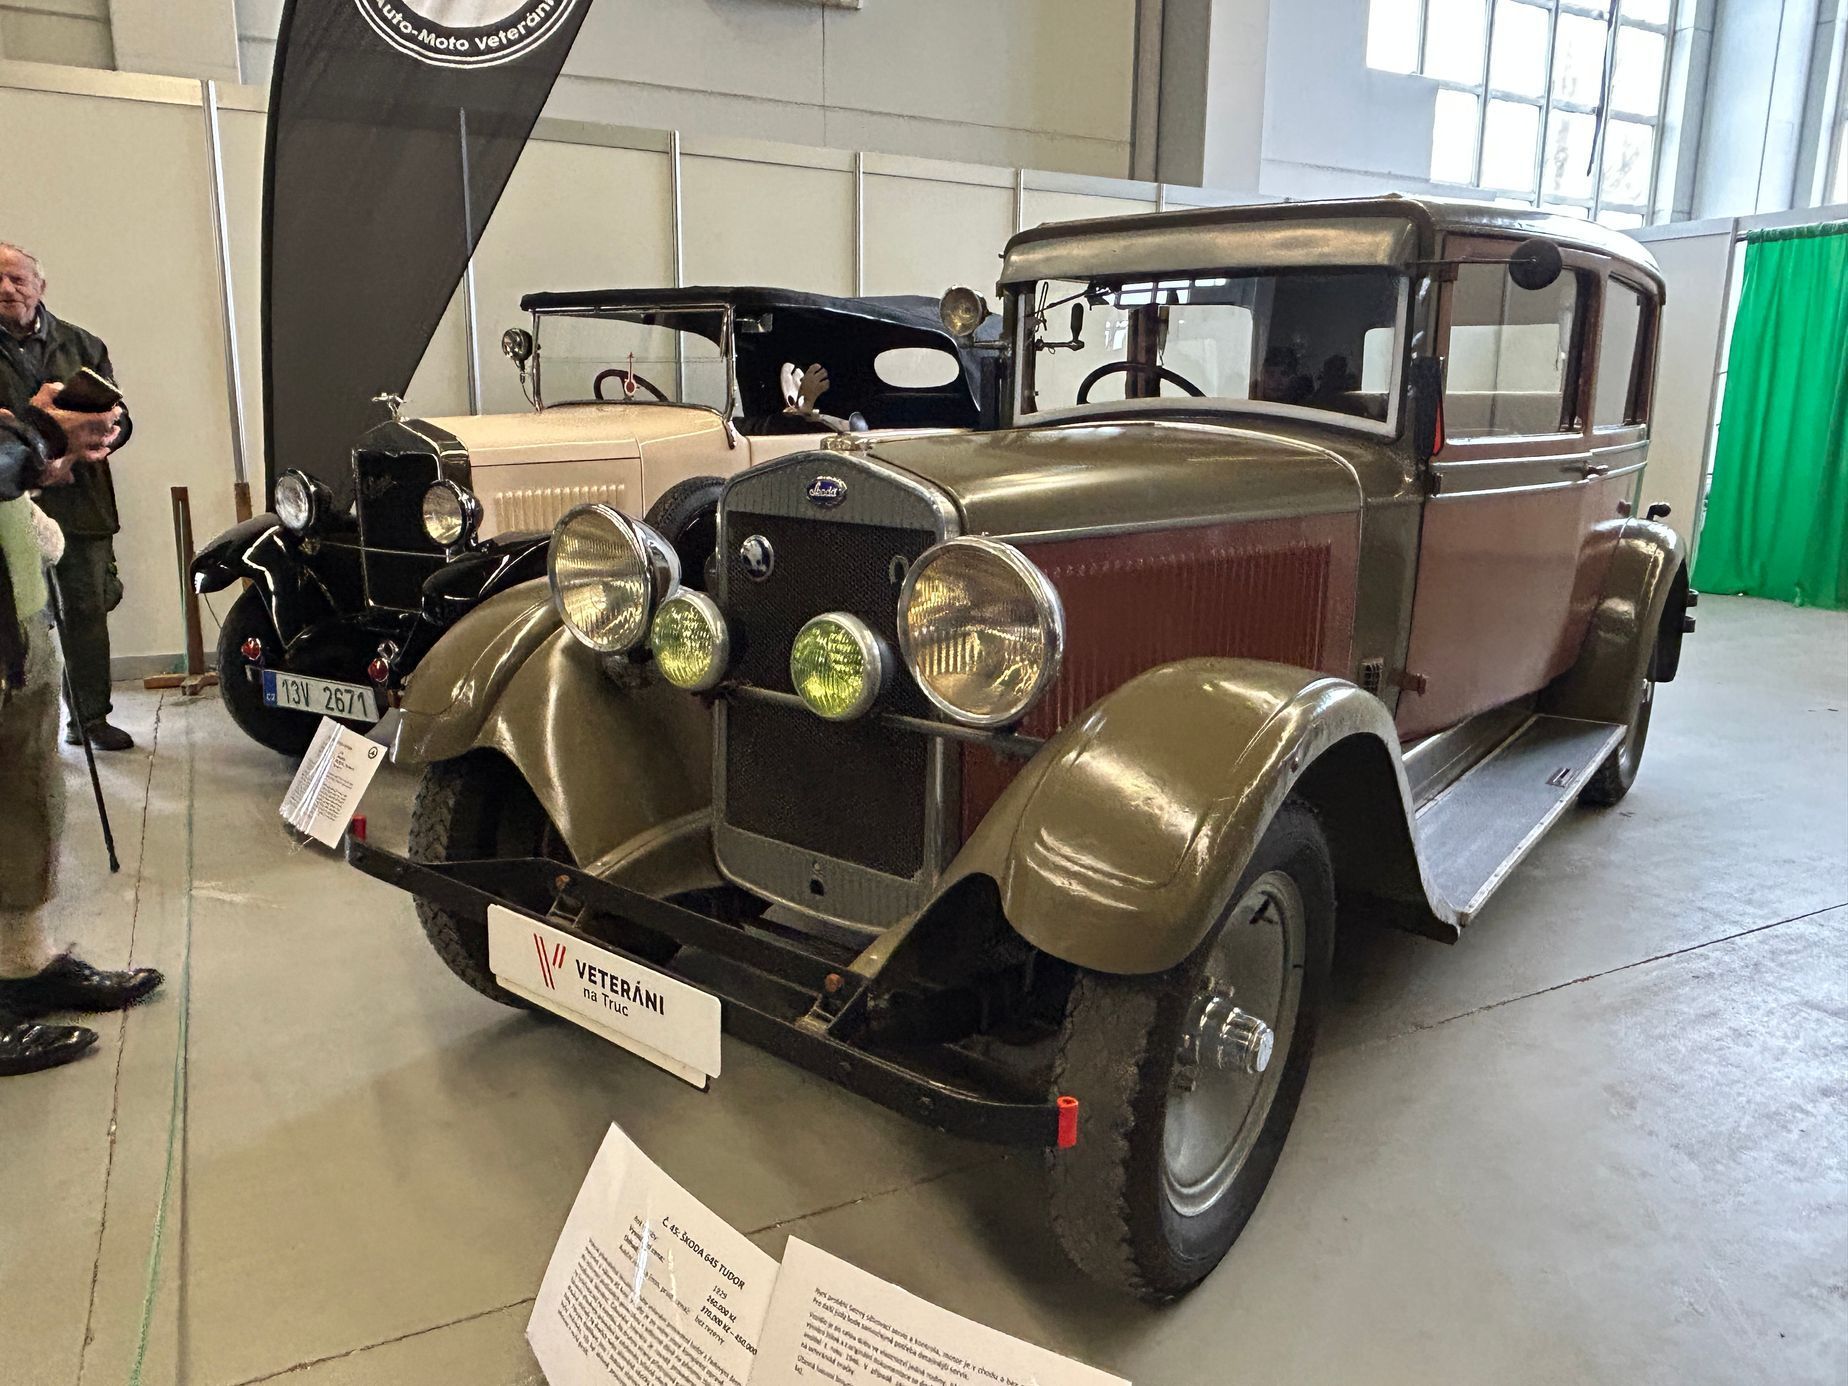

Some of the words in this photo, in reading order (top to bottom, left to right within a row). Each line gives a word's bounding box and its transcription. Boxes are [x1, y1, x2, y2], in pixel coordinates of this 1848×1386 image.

[282, 679, 310, 708] 13V
[323, 685, 368, 718] 2671
[575, 959, 665, 1016] VETERÁNI
[583, 986, 598, 1003] na
[601, 993, 629, 1017] Truc
[680, 1231, 704, 1258] ŠKODA
[703, 1252, 719, 1269] 645
[718, 1263, 746, 1291] TUDOR
